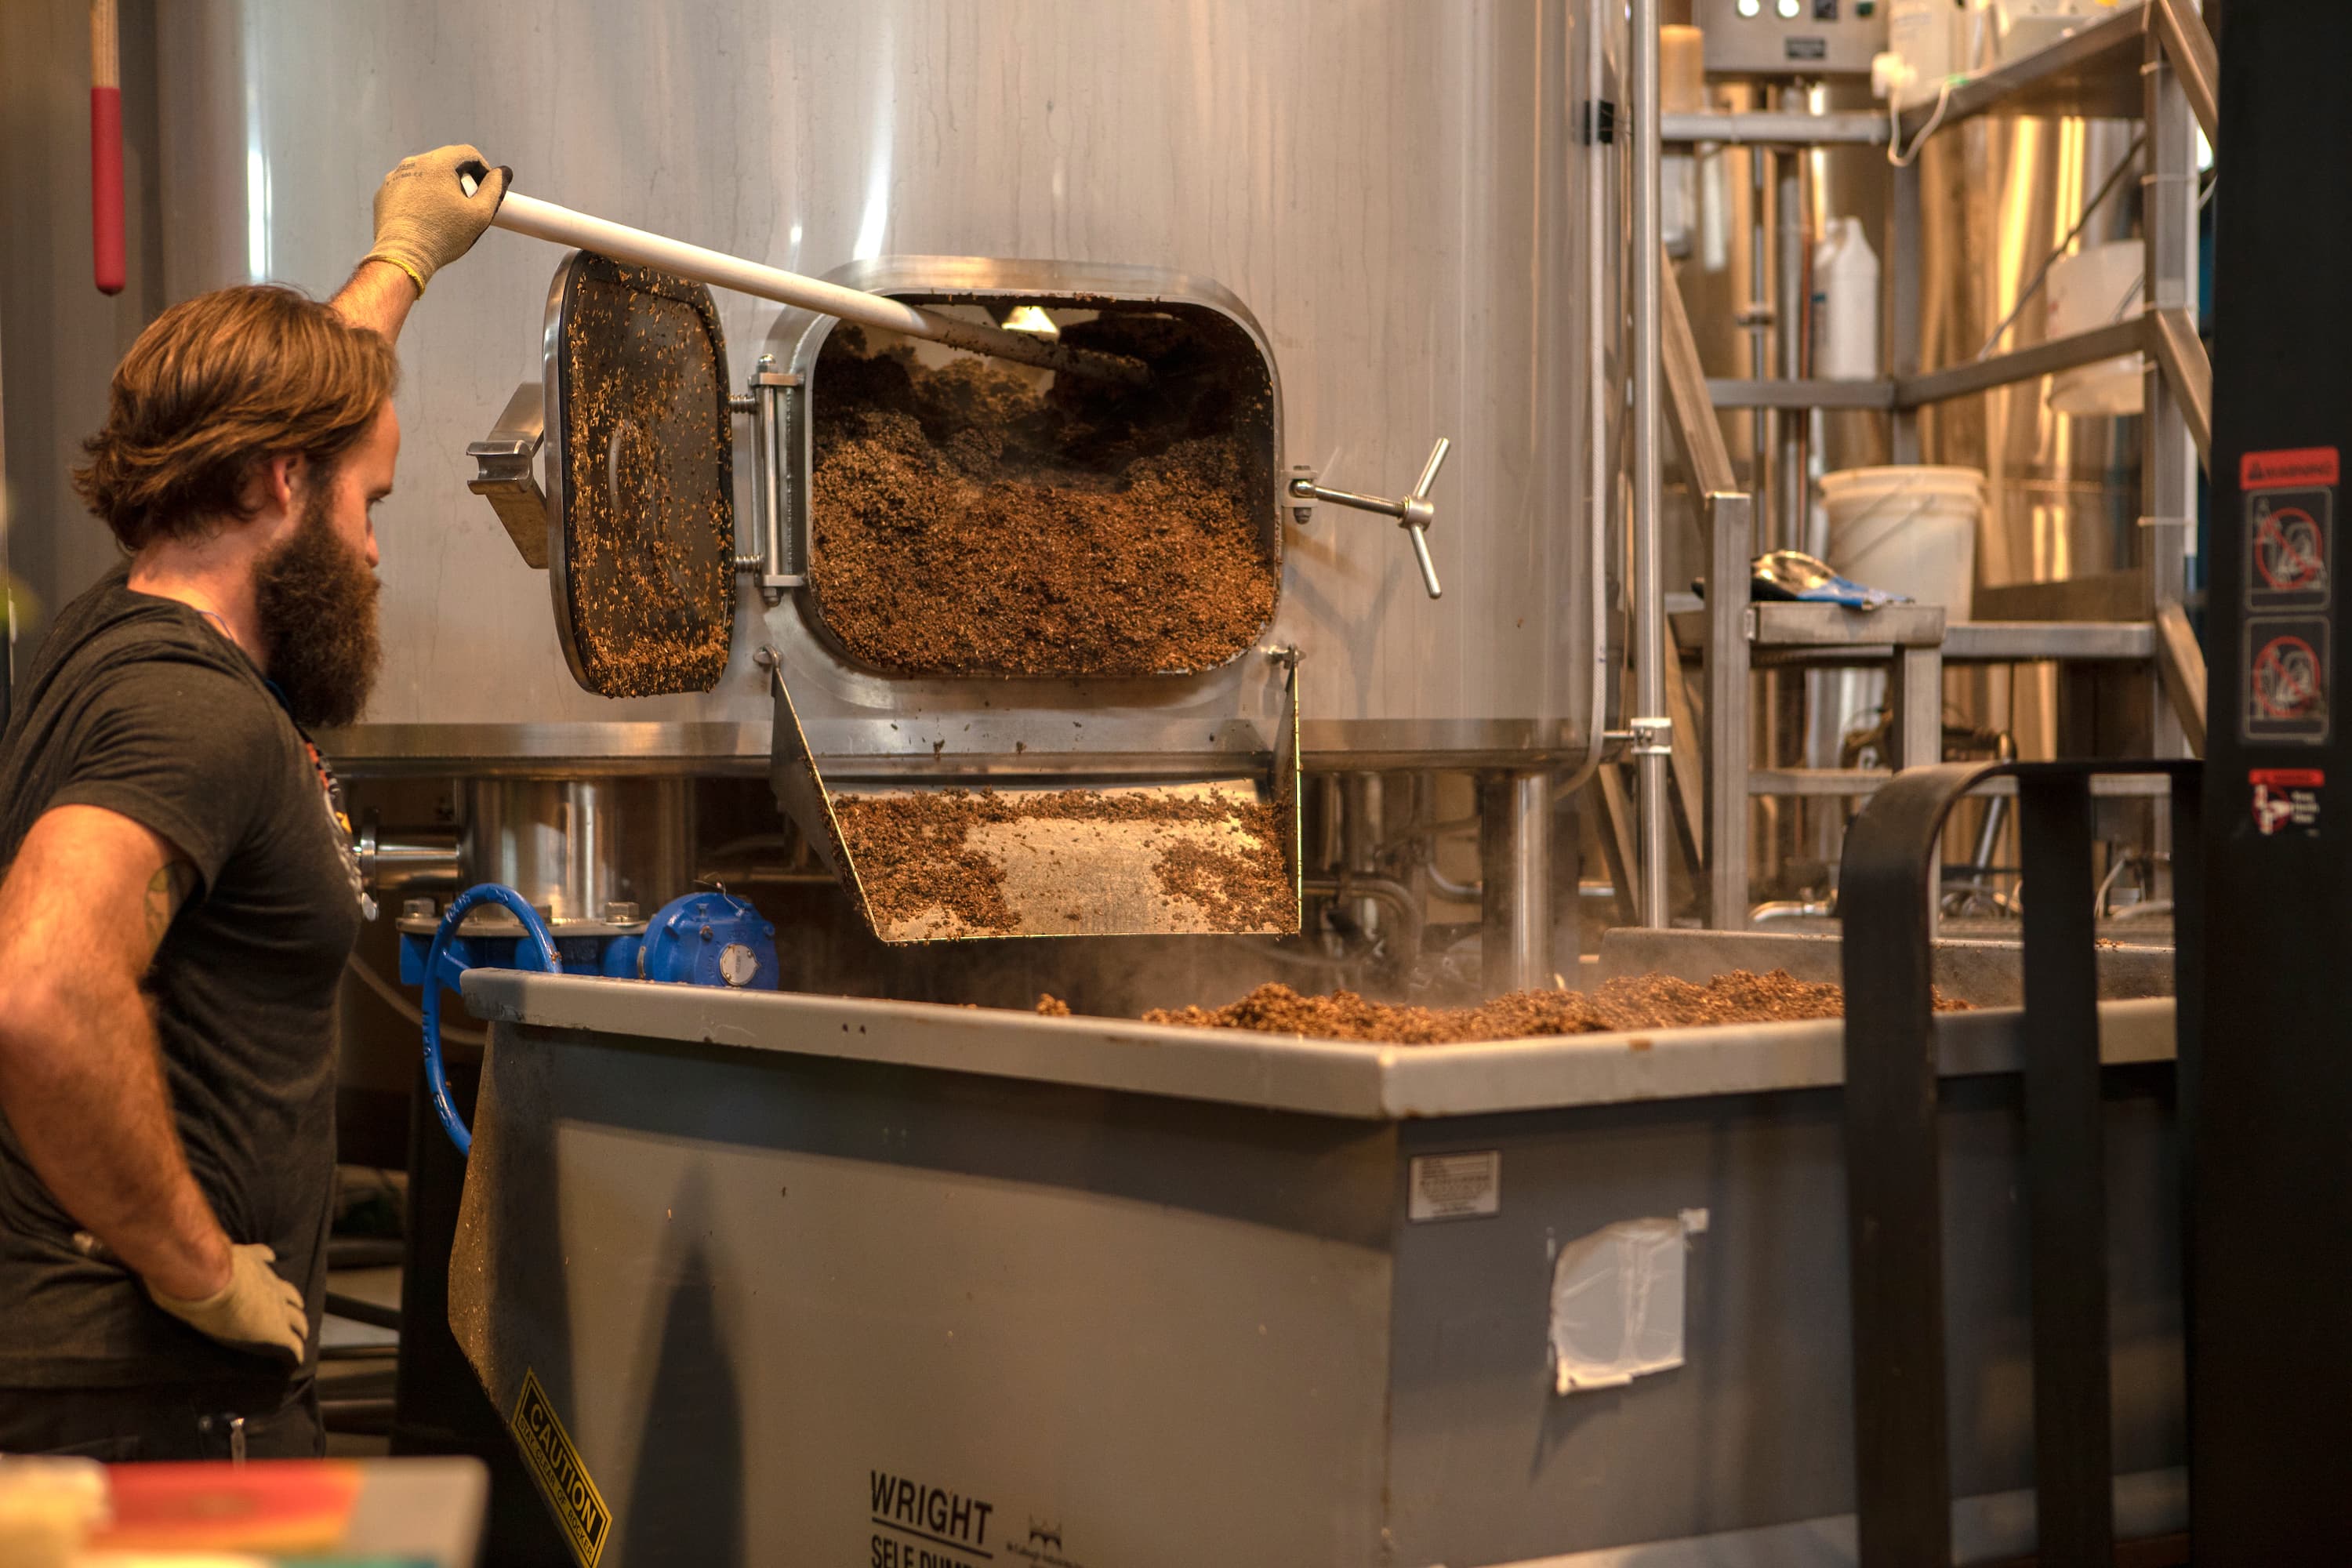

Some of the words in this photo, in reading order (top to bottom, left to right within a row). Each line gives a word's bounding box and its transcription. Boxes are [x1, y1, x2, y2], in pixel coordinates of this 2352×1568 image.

[518, 1416, 535, 1446] STAY
[535, 1448, 555, 1487] CLEAR
[557, 1488, 567, 1506] OF
[568, 1509, 593, 1558] ROCKER
[530, 1403, 597, 1534] CAUTION
[871, 1469, 993, 1544] WRIGHT
